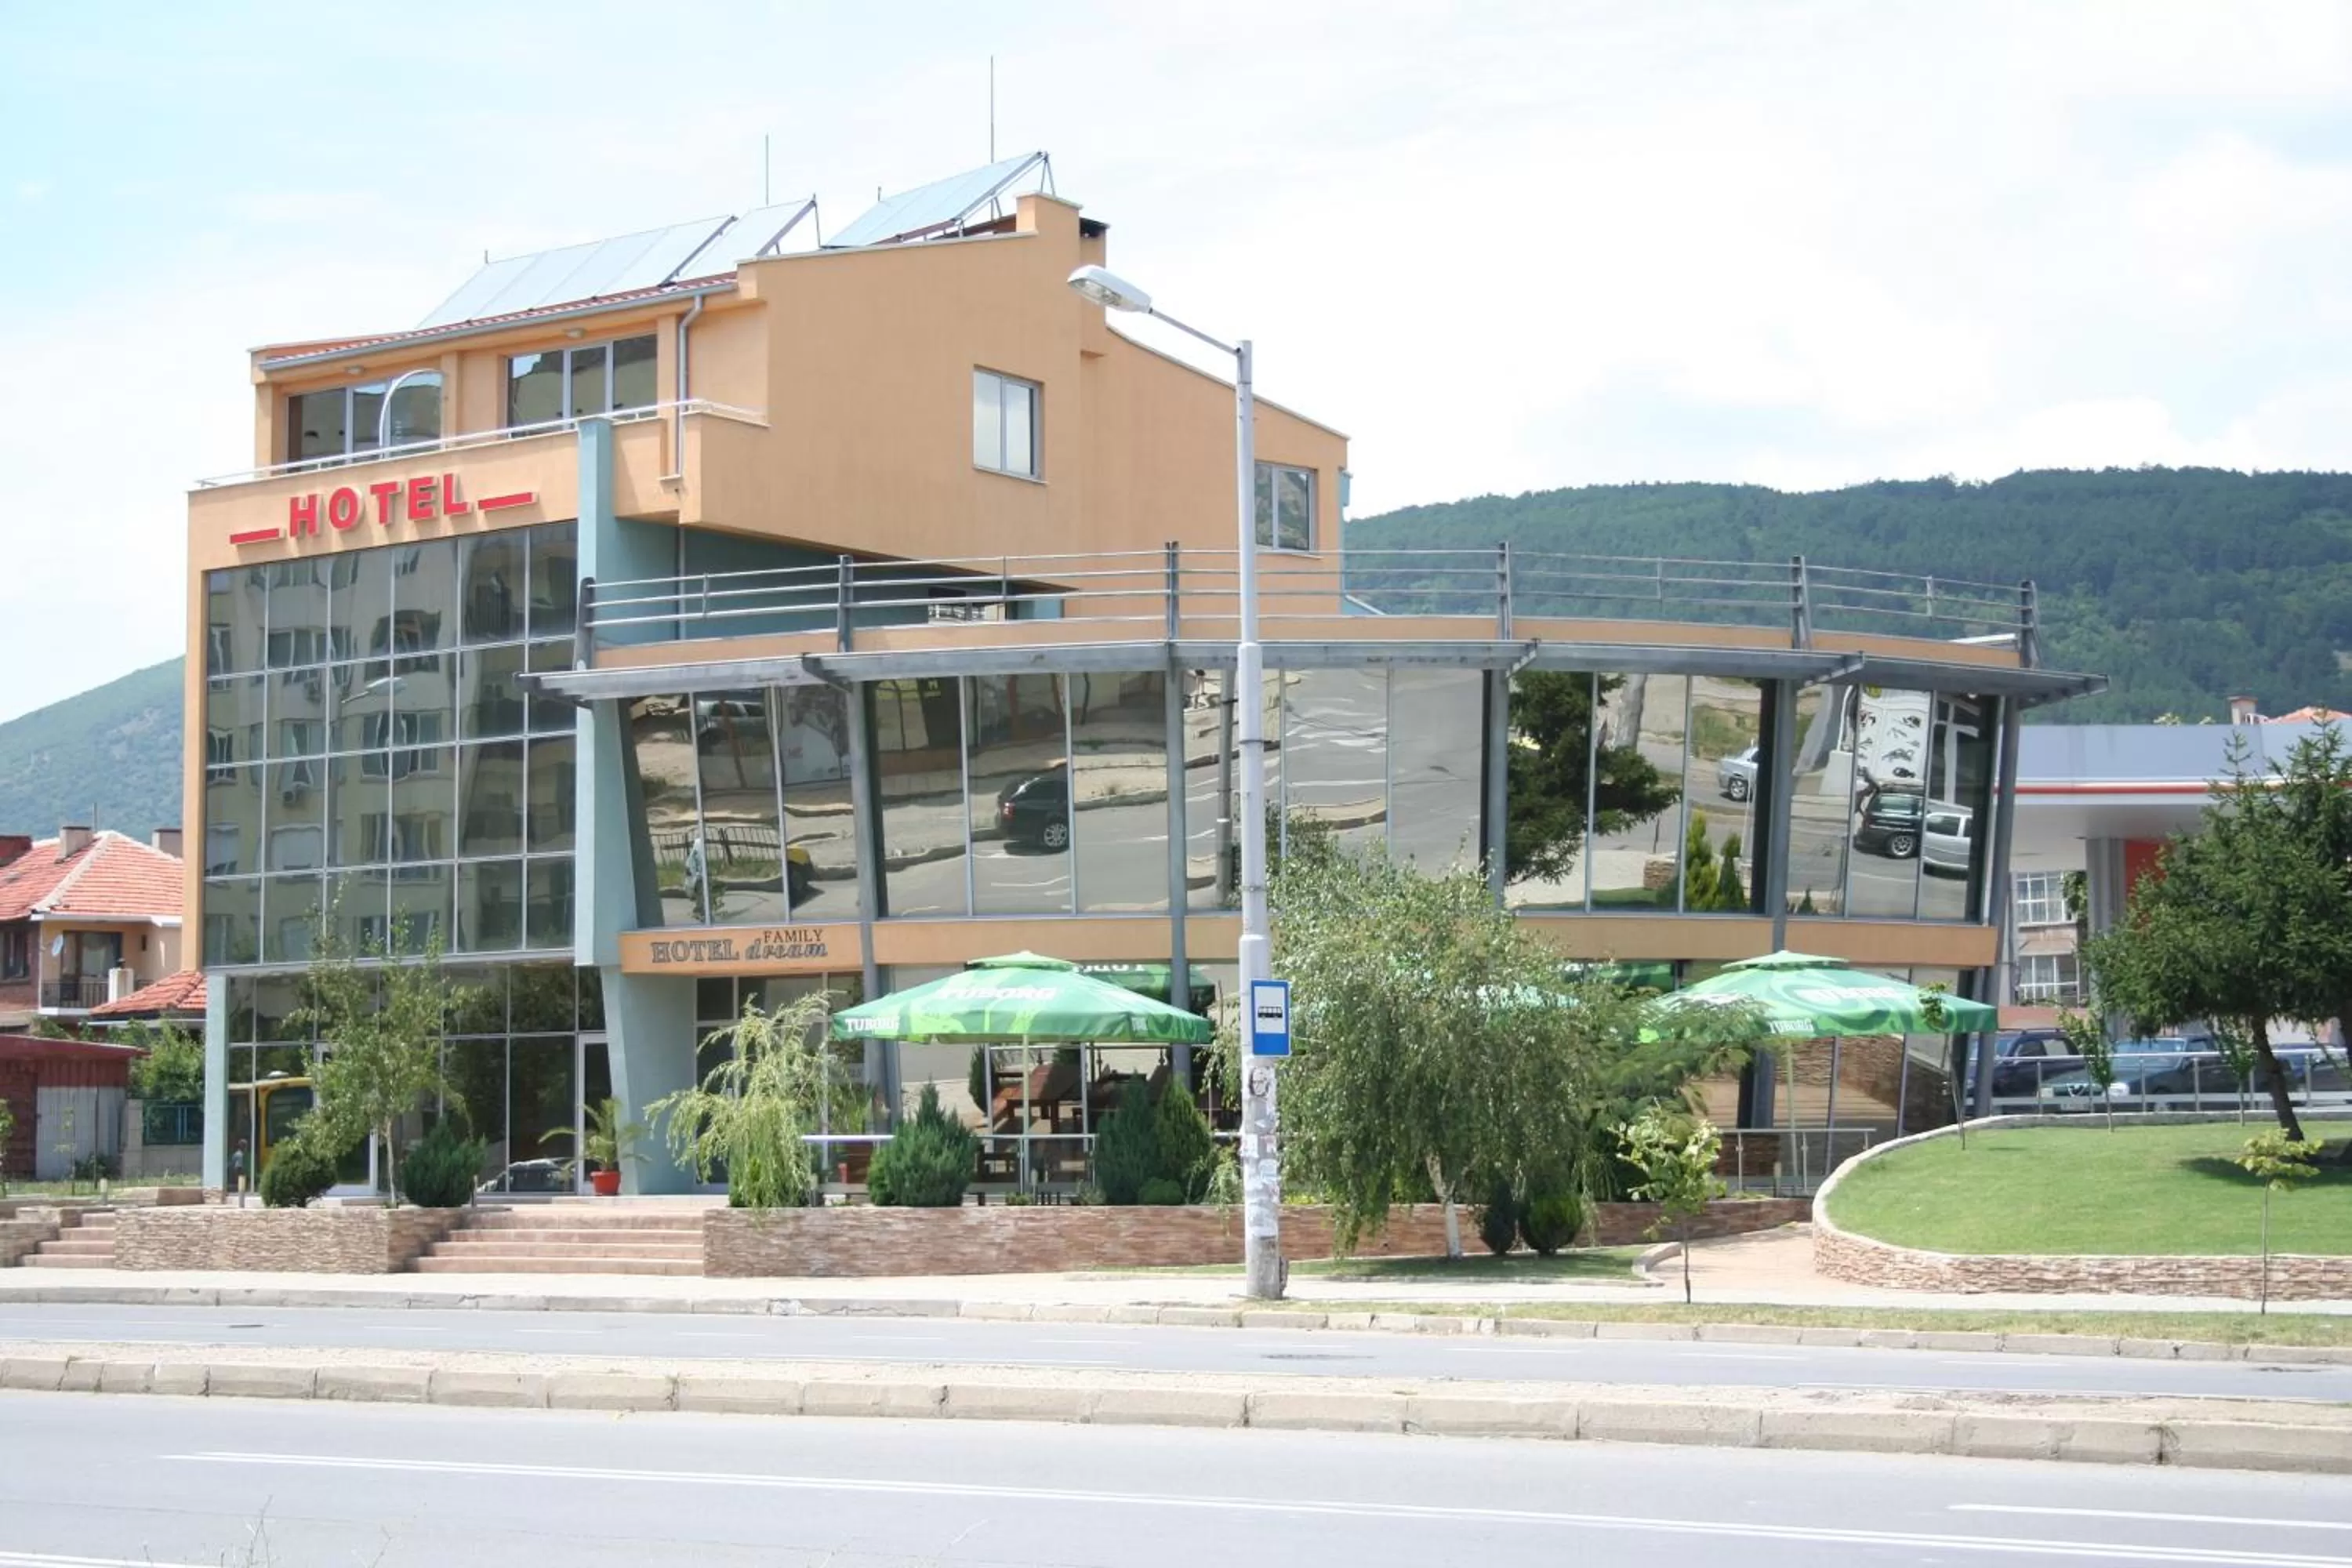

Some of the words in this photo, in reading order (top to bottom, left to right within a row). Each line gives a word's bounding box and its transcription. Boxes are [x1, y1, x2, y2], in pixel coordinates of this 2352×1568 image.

[289, 472, 469, 537] HOTEL
[764, 928, 822, 943] FAMILY
[651, 938, 739, 963] HOTEL
[746, 938, 828, 960] dream
